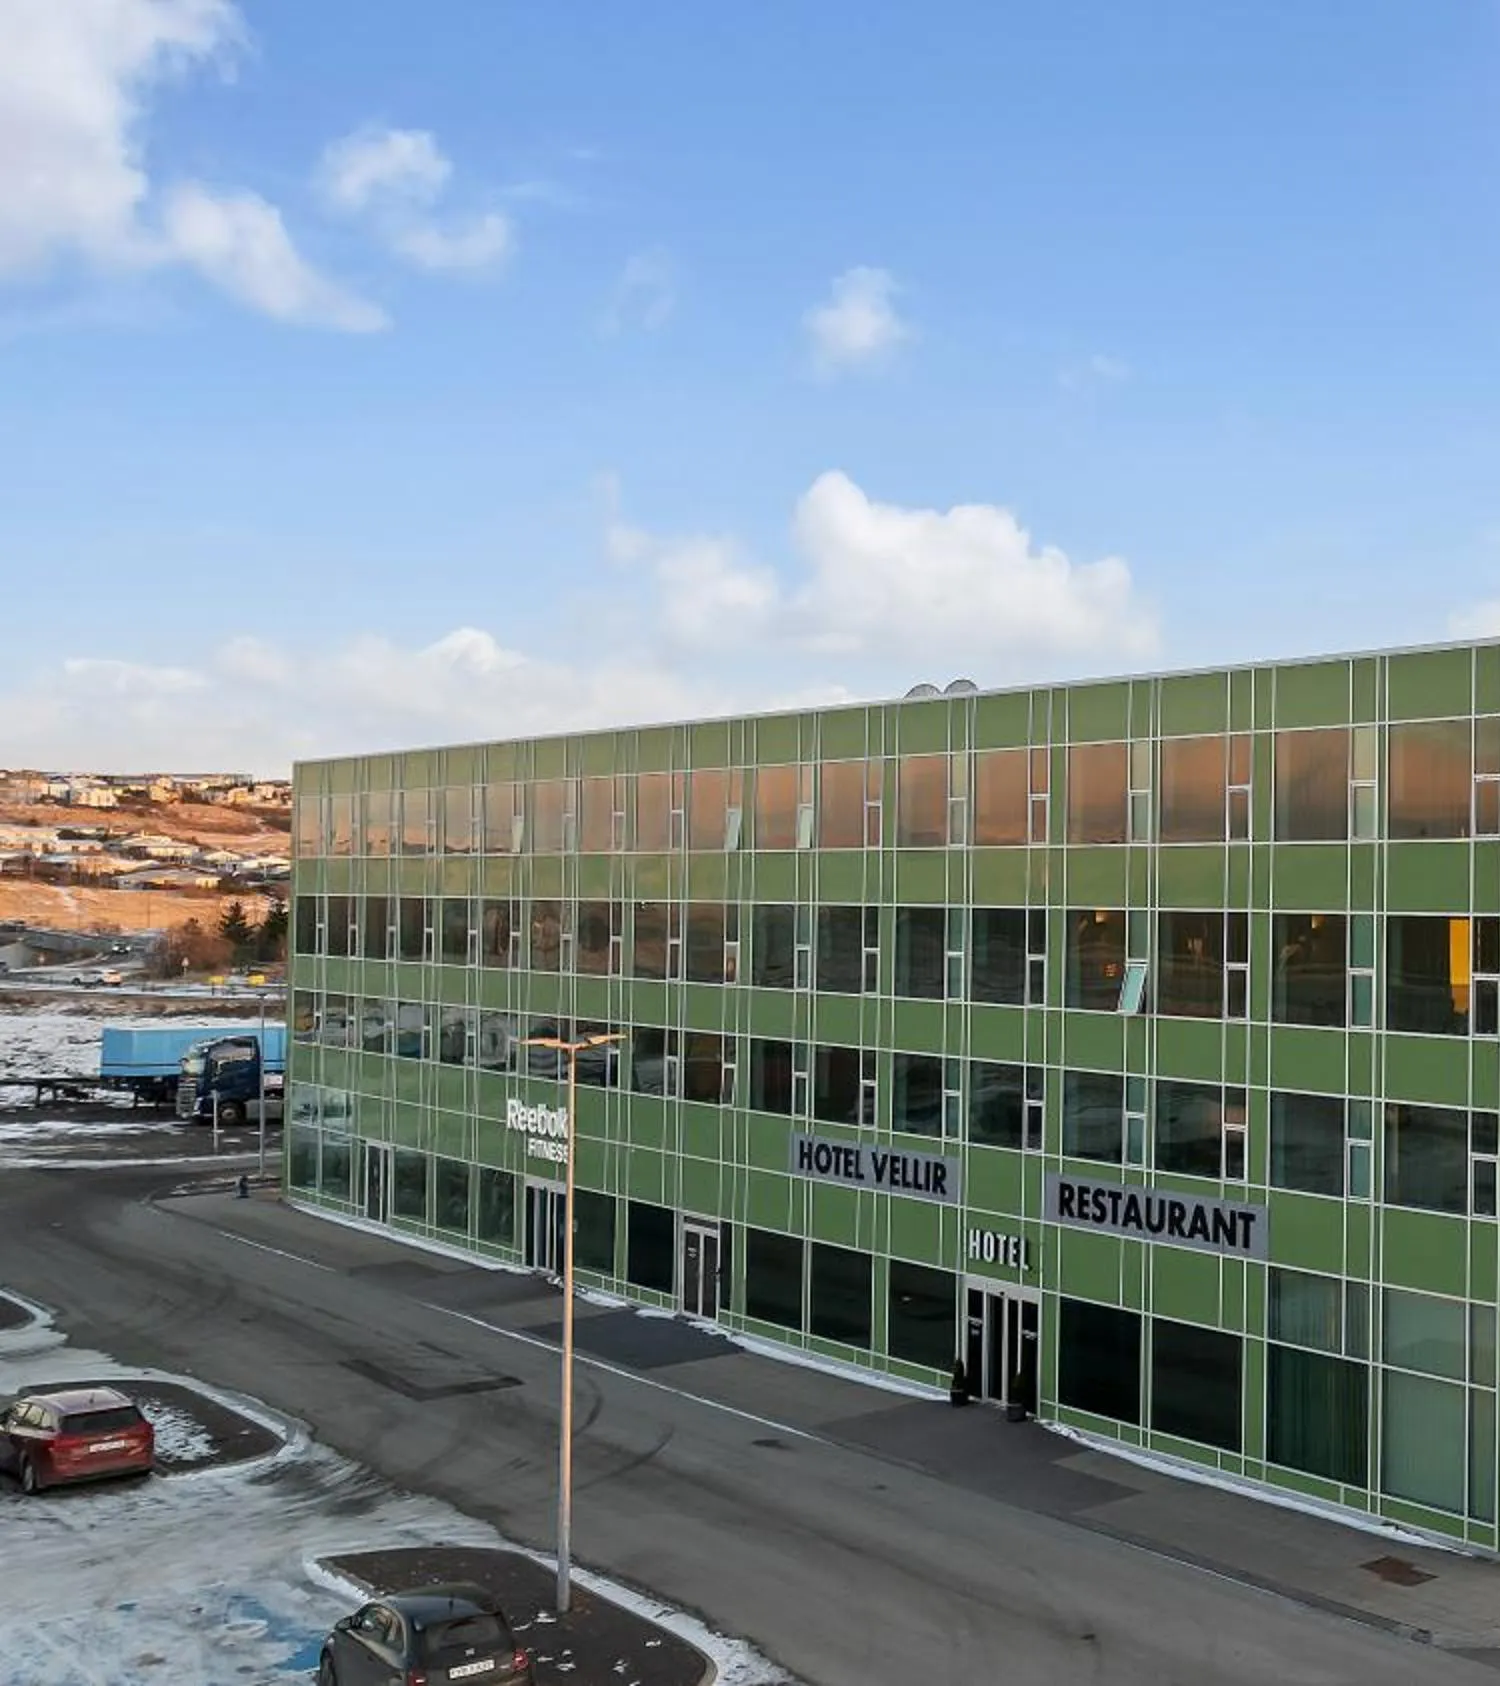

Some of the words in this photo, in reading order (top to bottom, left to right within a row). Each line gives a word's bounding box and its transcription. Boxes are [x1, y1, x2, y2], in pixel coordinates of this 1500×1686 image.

[507, 1099, 568, 1139] Reebok
[799, 1140, 864, 1180] HOTEL
[871, 1152, 946, 1195] VELLIR
[1058, 1182, 1256, 1249] RESTAURANT
[968, 1228, 1029, 1271] HOTEL
